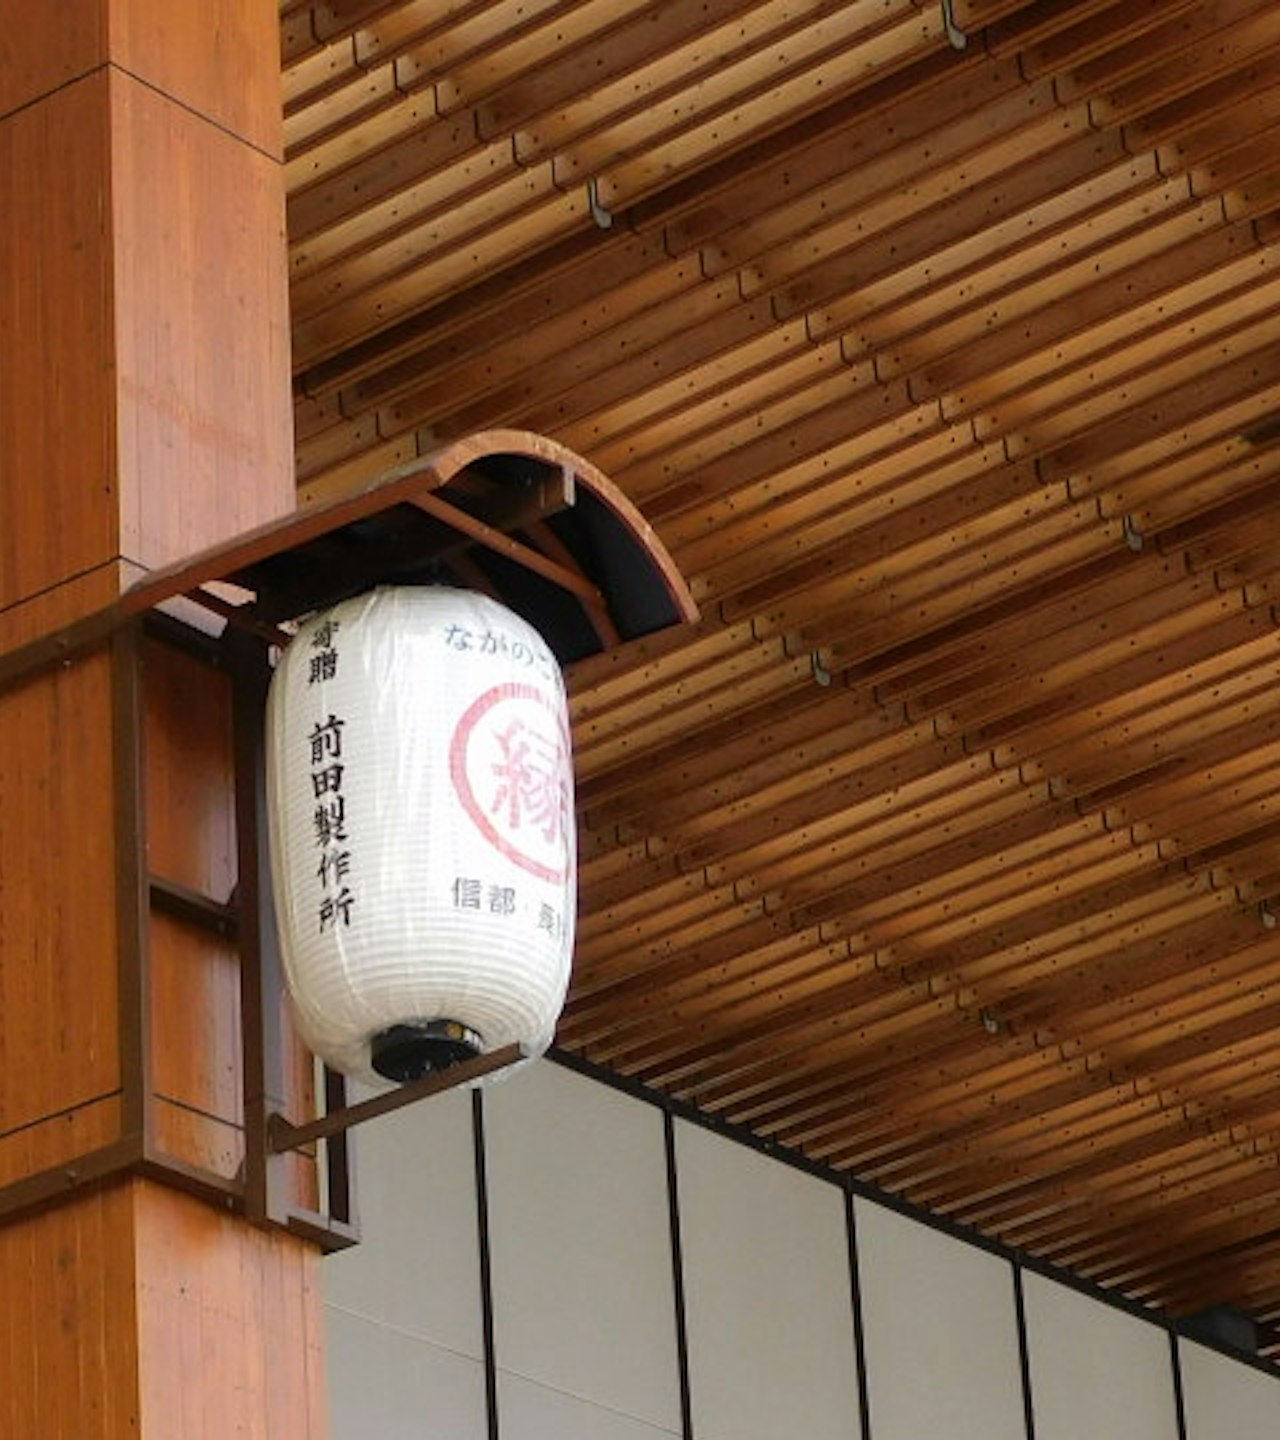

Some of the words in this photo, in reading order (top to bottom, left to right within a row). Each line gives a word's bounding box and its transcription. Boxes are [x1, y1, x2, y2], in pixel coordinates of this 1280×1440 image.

[307, 714, 356, 935] 前田製作所
